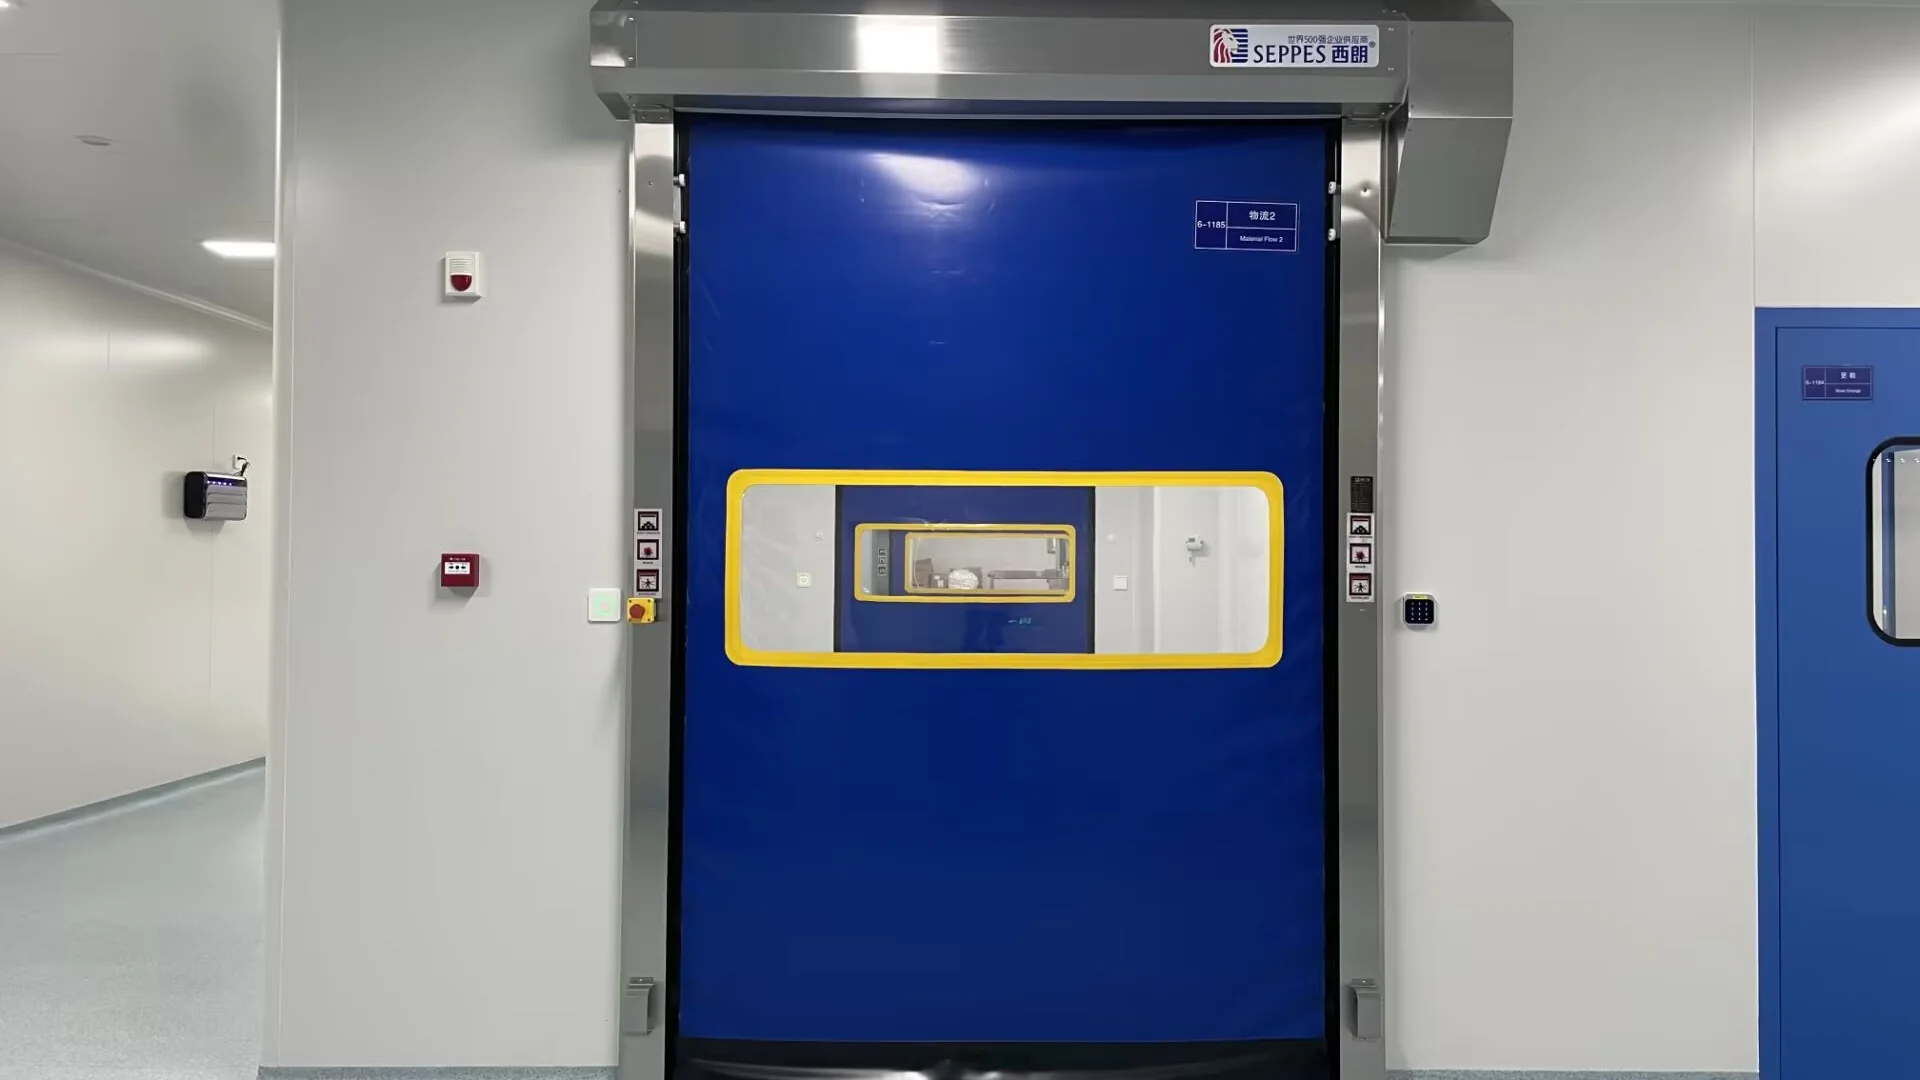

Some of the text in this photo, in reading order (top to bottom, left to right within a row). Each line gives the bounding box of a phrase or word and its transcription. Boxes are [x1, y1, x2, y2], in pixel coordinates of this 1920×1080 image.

[1253, 45, 1369, 63] SEPPES 西朗
[1248, 210, 1276, 221] 物流2
[1197, 220, 1226, 229] 6-1185
[1264, 235, 1278, 243] Flow
